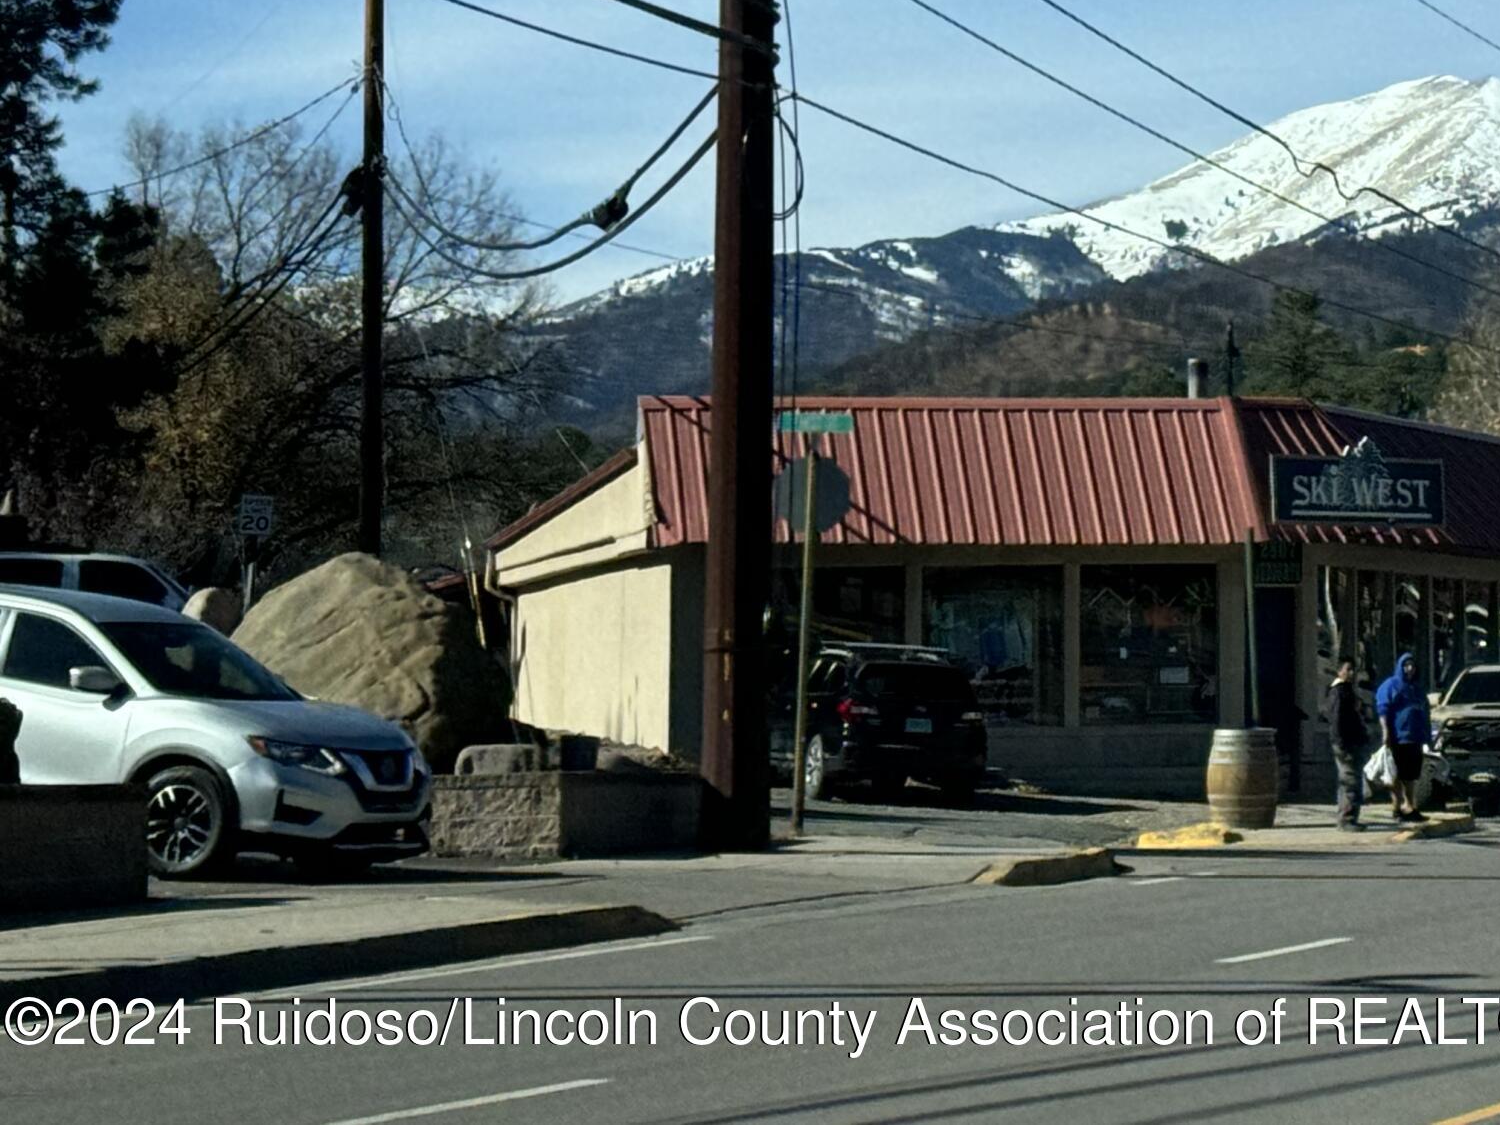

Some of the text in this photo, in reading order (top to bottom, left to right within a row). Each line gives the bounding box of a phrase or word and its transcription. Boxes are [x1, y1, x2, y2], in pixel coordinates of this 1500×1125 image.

[1292, 475, 1430, 509] SKI WEST
[241, 515, 269, 531] 20
